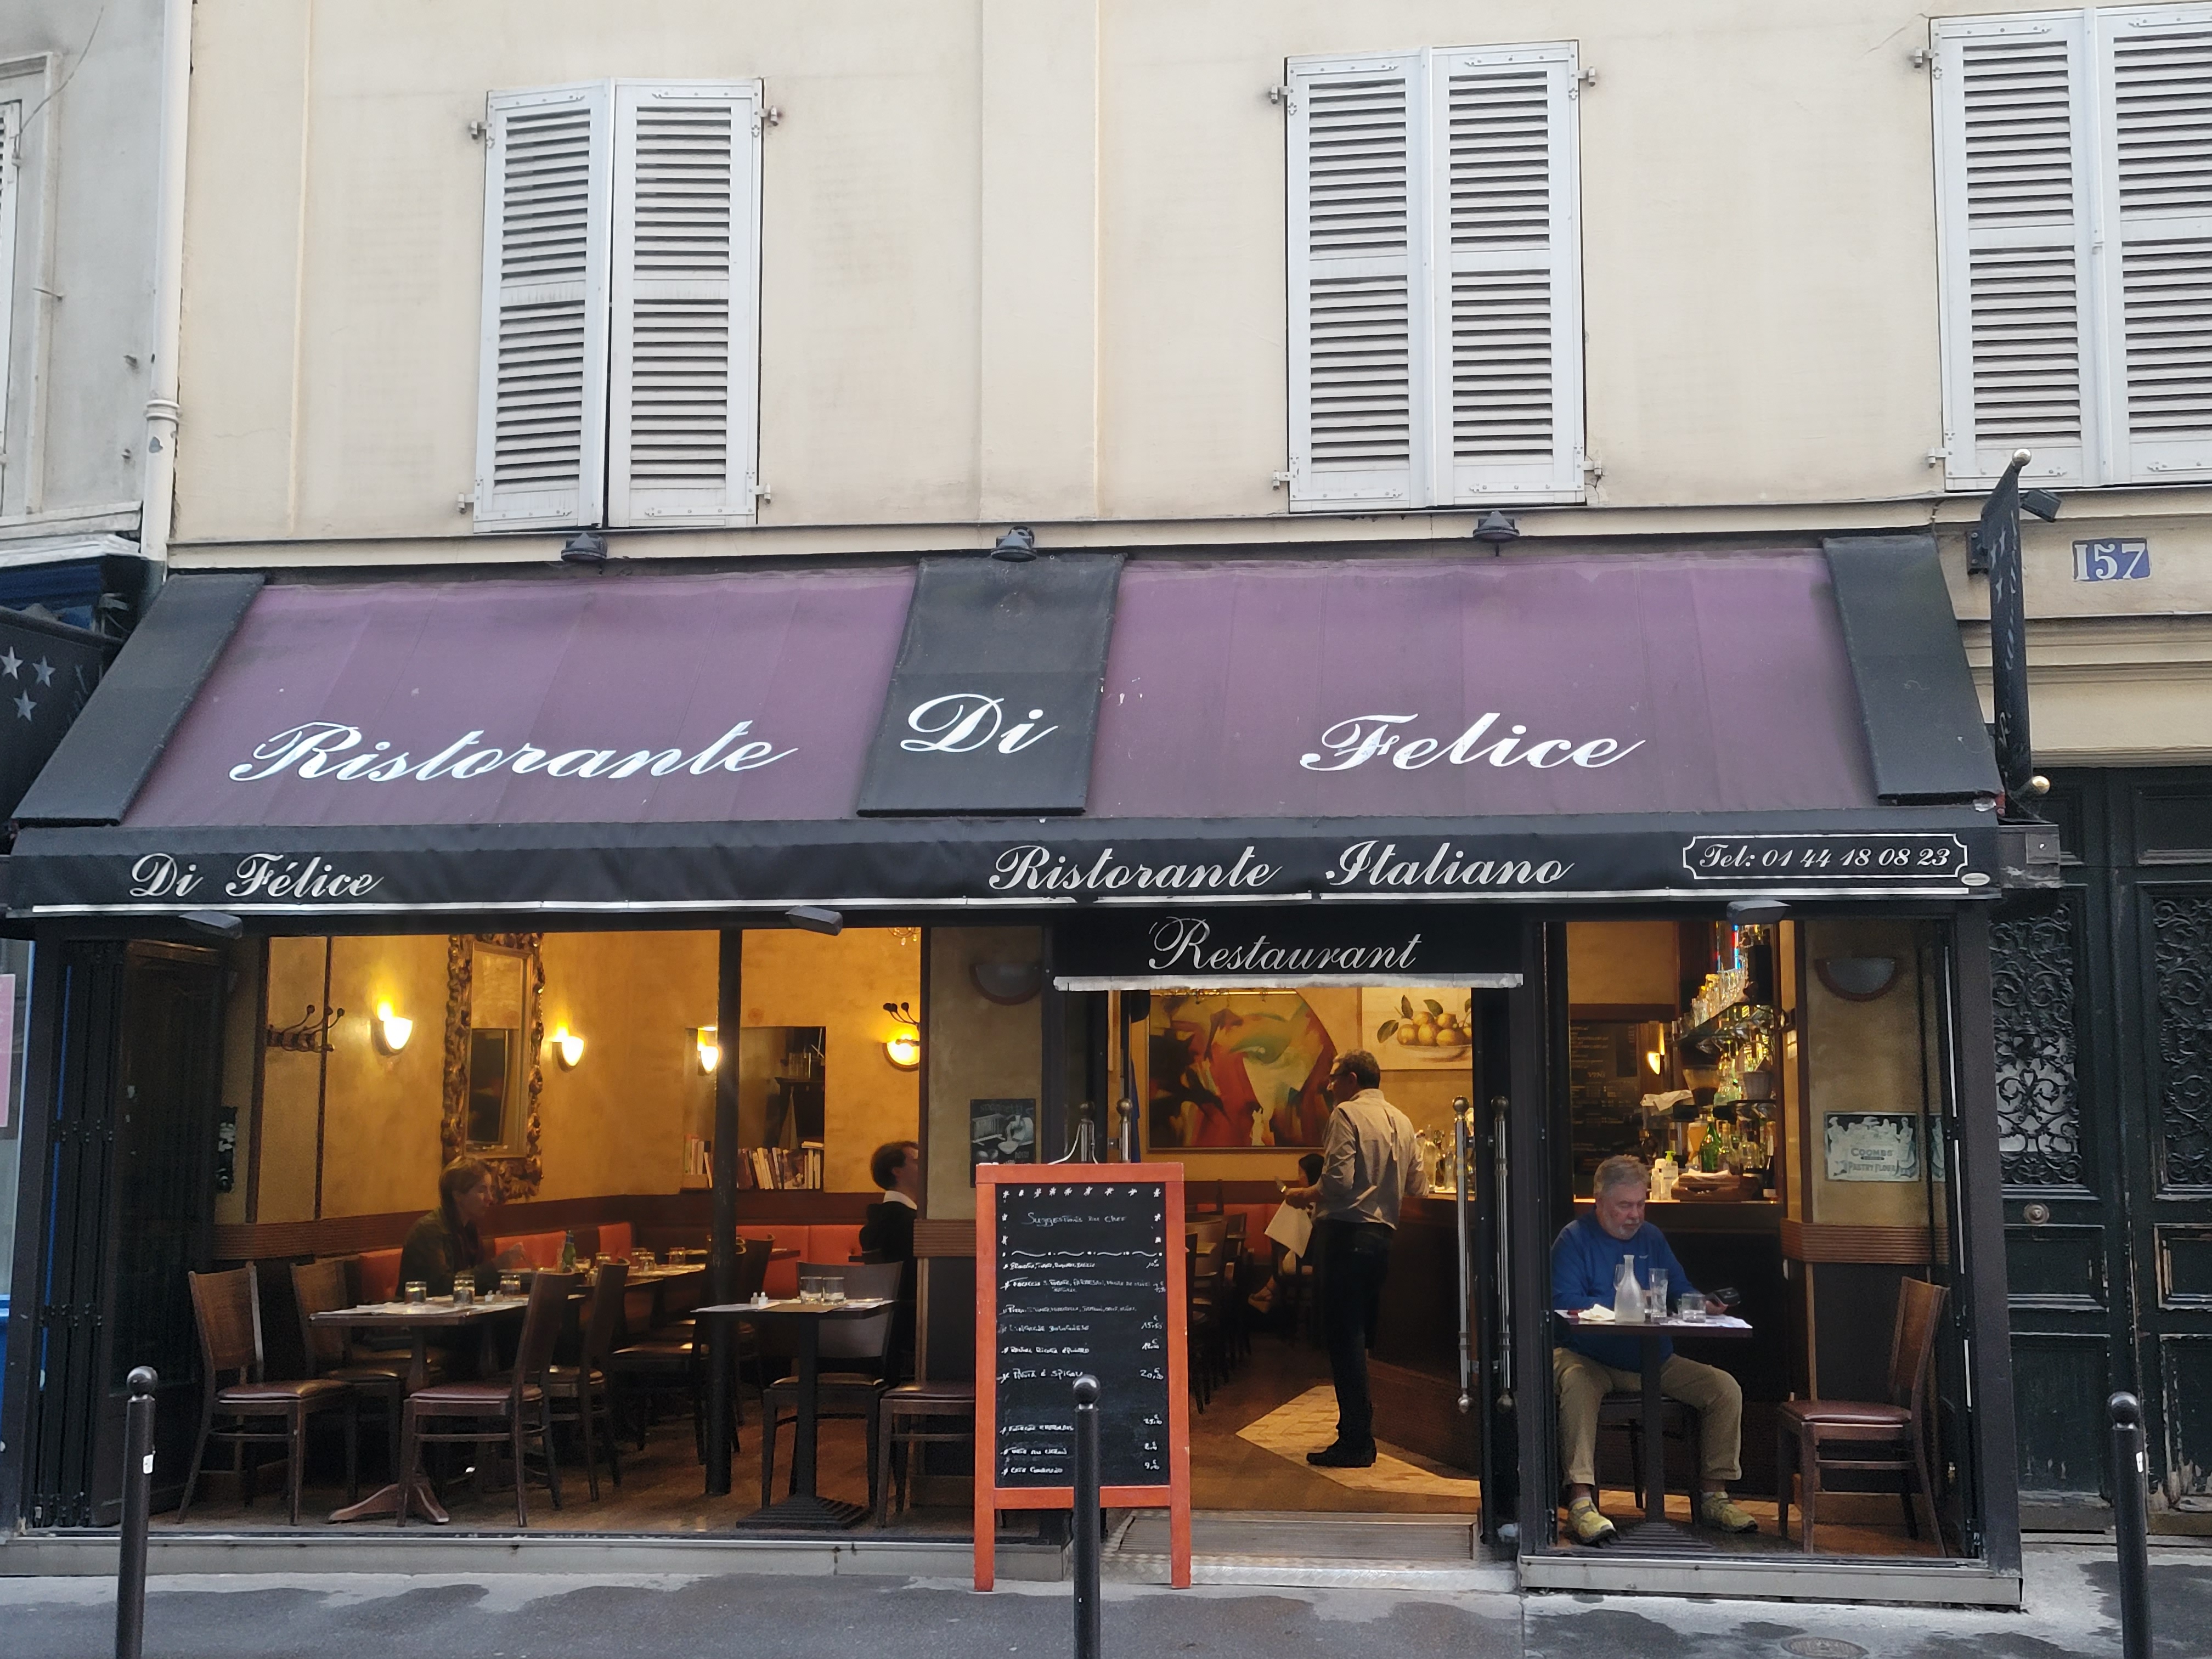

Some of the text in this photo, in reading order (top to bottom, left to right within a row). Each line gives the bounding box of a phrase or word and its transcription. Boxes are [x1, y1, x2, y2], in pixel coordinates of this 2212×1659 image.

[2074, 543, 2145, 580] 157
[228, 693, 1647, 782] Ristorante Di Felice
[129, 853, 385, 898] Di Félice
[988, 839, 1575, 890] Ristorante Italiano
[1700, 844, 1951, 868] Tel: 01 44 18 08 23
[1147, 916, 1423, 970] Restaurant
